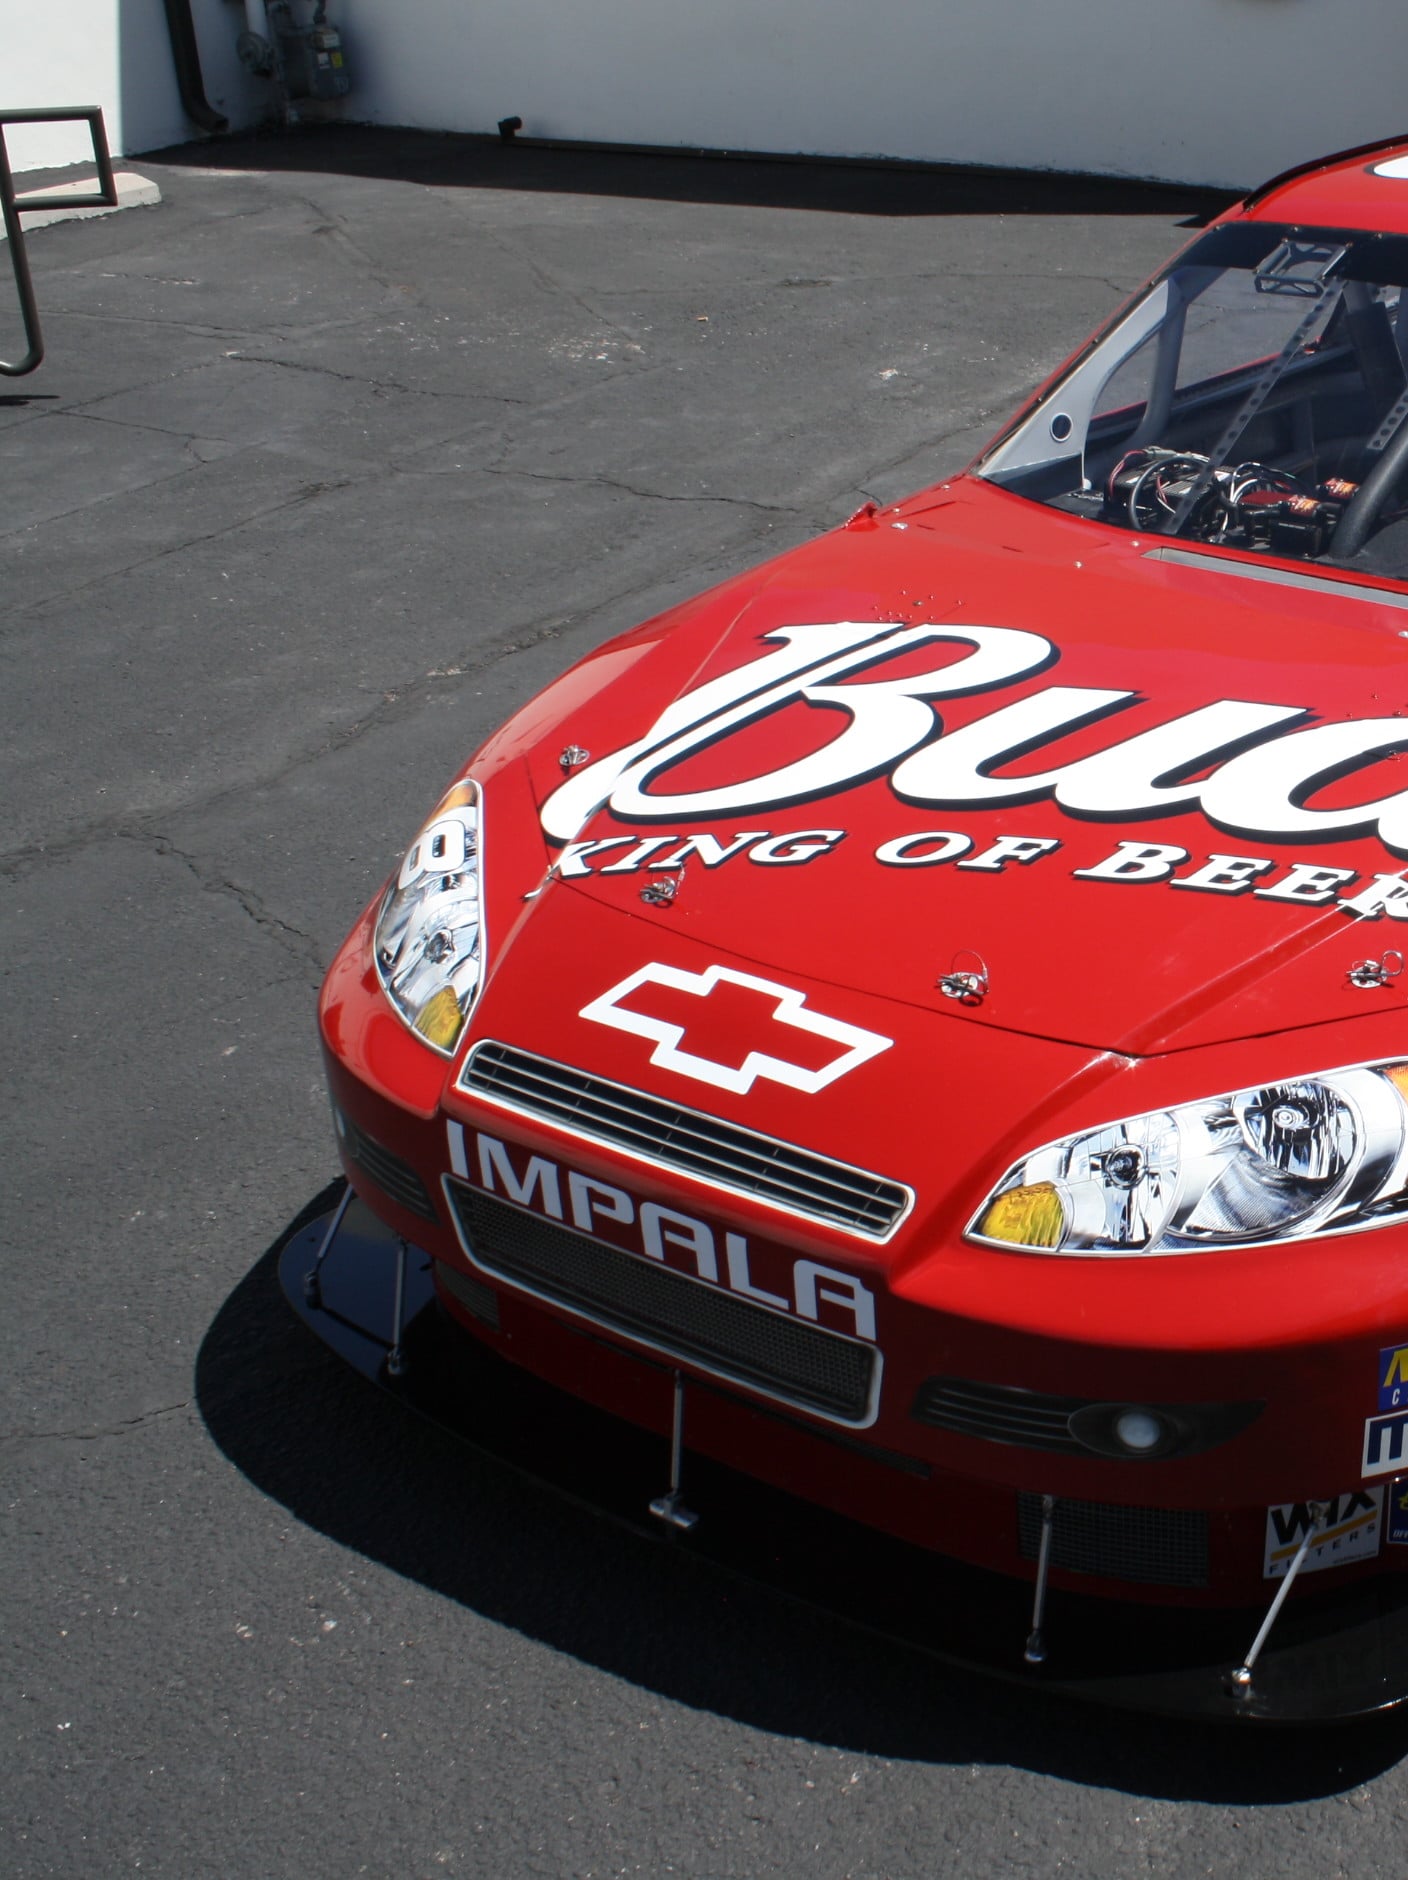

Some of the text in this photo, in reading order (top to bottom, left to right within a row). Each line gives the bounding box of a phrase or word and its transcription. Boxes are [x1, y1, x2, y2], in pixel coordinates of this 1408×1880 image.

[525, 829, 847, 899] KING
[876, 831, 1063, 874] OF
[446, 1118, 877, 1342] IMPALA
[1269, 1522, 1376, 1575] FITERS
